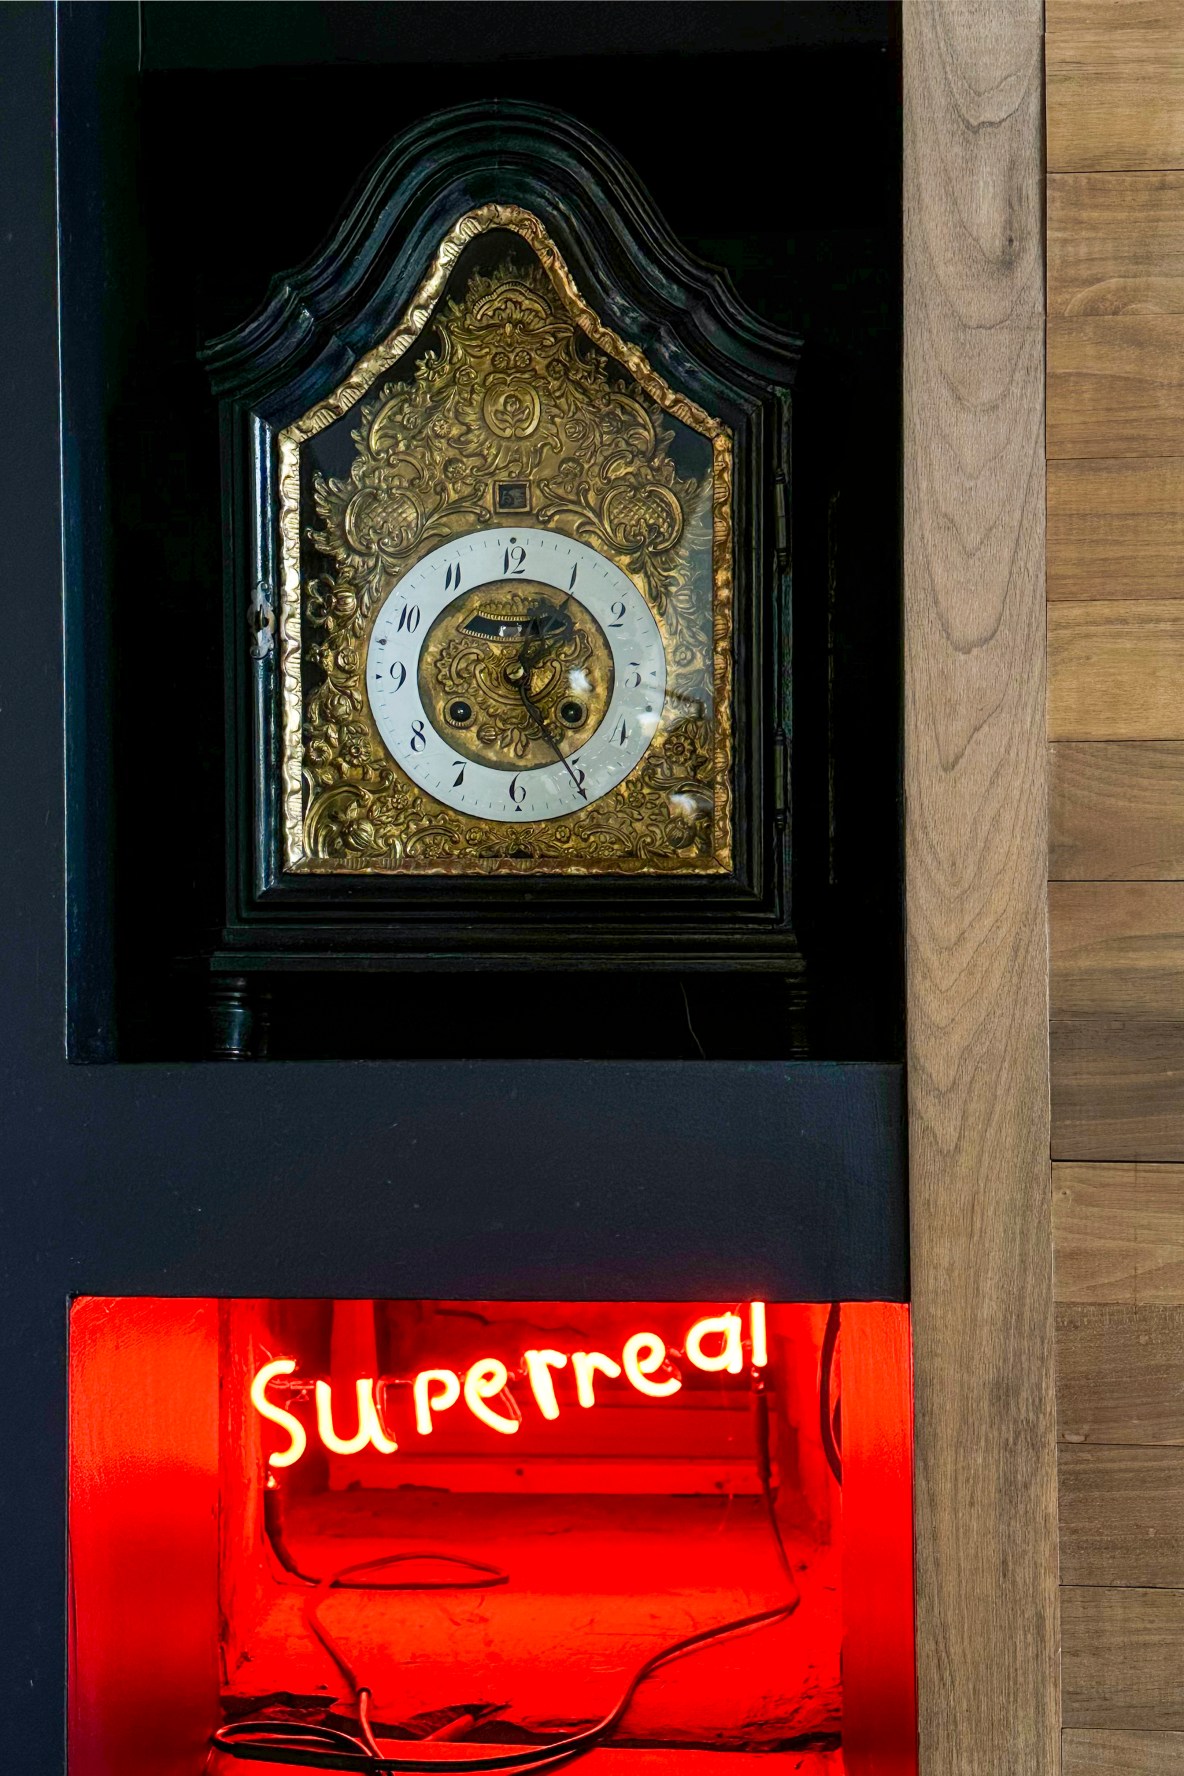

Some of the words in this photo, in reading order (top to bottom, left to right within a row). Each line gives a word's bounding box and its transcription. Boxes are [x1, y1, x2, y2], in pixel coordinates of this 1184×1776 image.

[503, 546, 526, 575] 12
[445, 562, 461, 591] 11
[568, 562, 578, 590] 1
[397, 603, 420, 633] 10
[608, 602, 626, 628] 2
[390, 661, 406, 694] 9
[624, 662, 642, 688] 3
[410, 720, 426, 752] 8
[609, 713, 628, 746] 4
[452, 760, 467, 788] 7
[508, 772, 526, 804] 6
